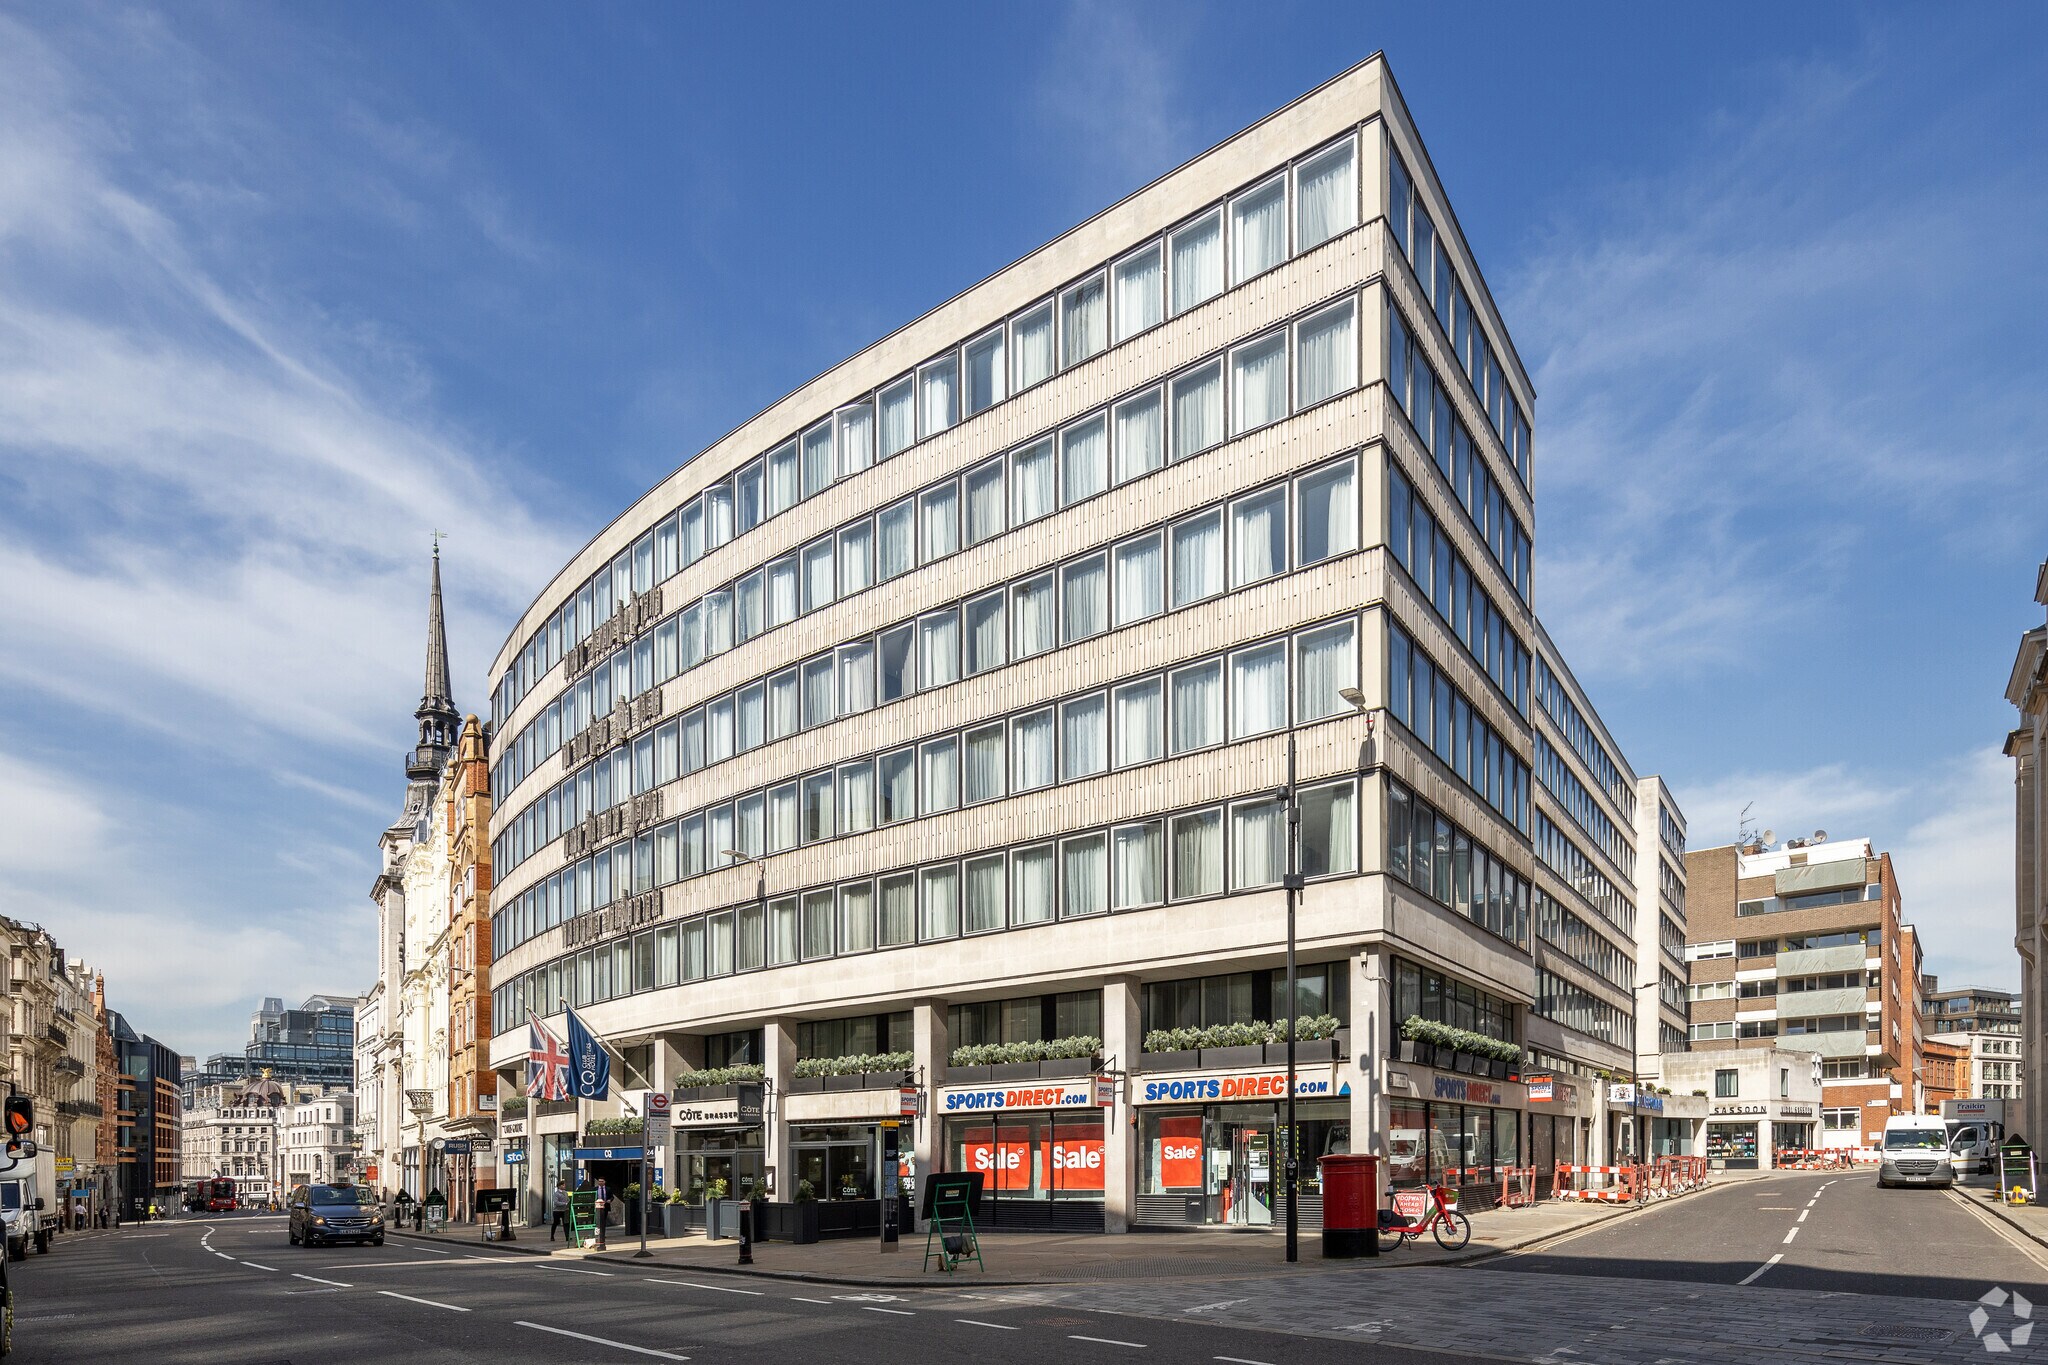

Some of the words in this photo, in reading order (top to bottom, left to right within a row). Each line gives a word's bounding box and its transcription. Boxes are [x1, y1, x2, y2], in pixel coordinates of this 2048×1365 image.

[580, 1070, 596, 1096] CQ
[679, 1108, 703, 1121] CÔTE
[704, 1111, 739, 1120] BRASSER
[740, 1105, 761, 1113] CÔTE
[1714, 1105, 1767, 1114] SASSOON
[975, 1147, 1020, 1169] Sale
[1053, 1145, 1101, 1169] Sale
[1164, 1145, 1196, 1160] Sale
